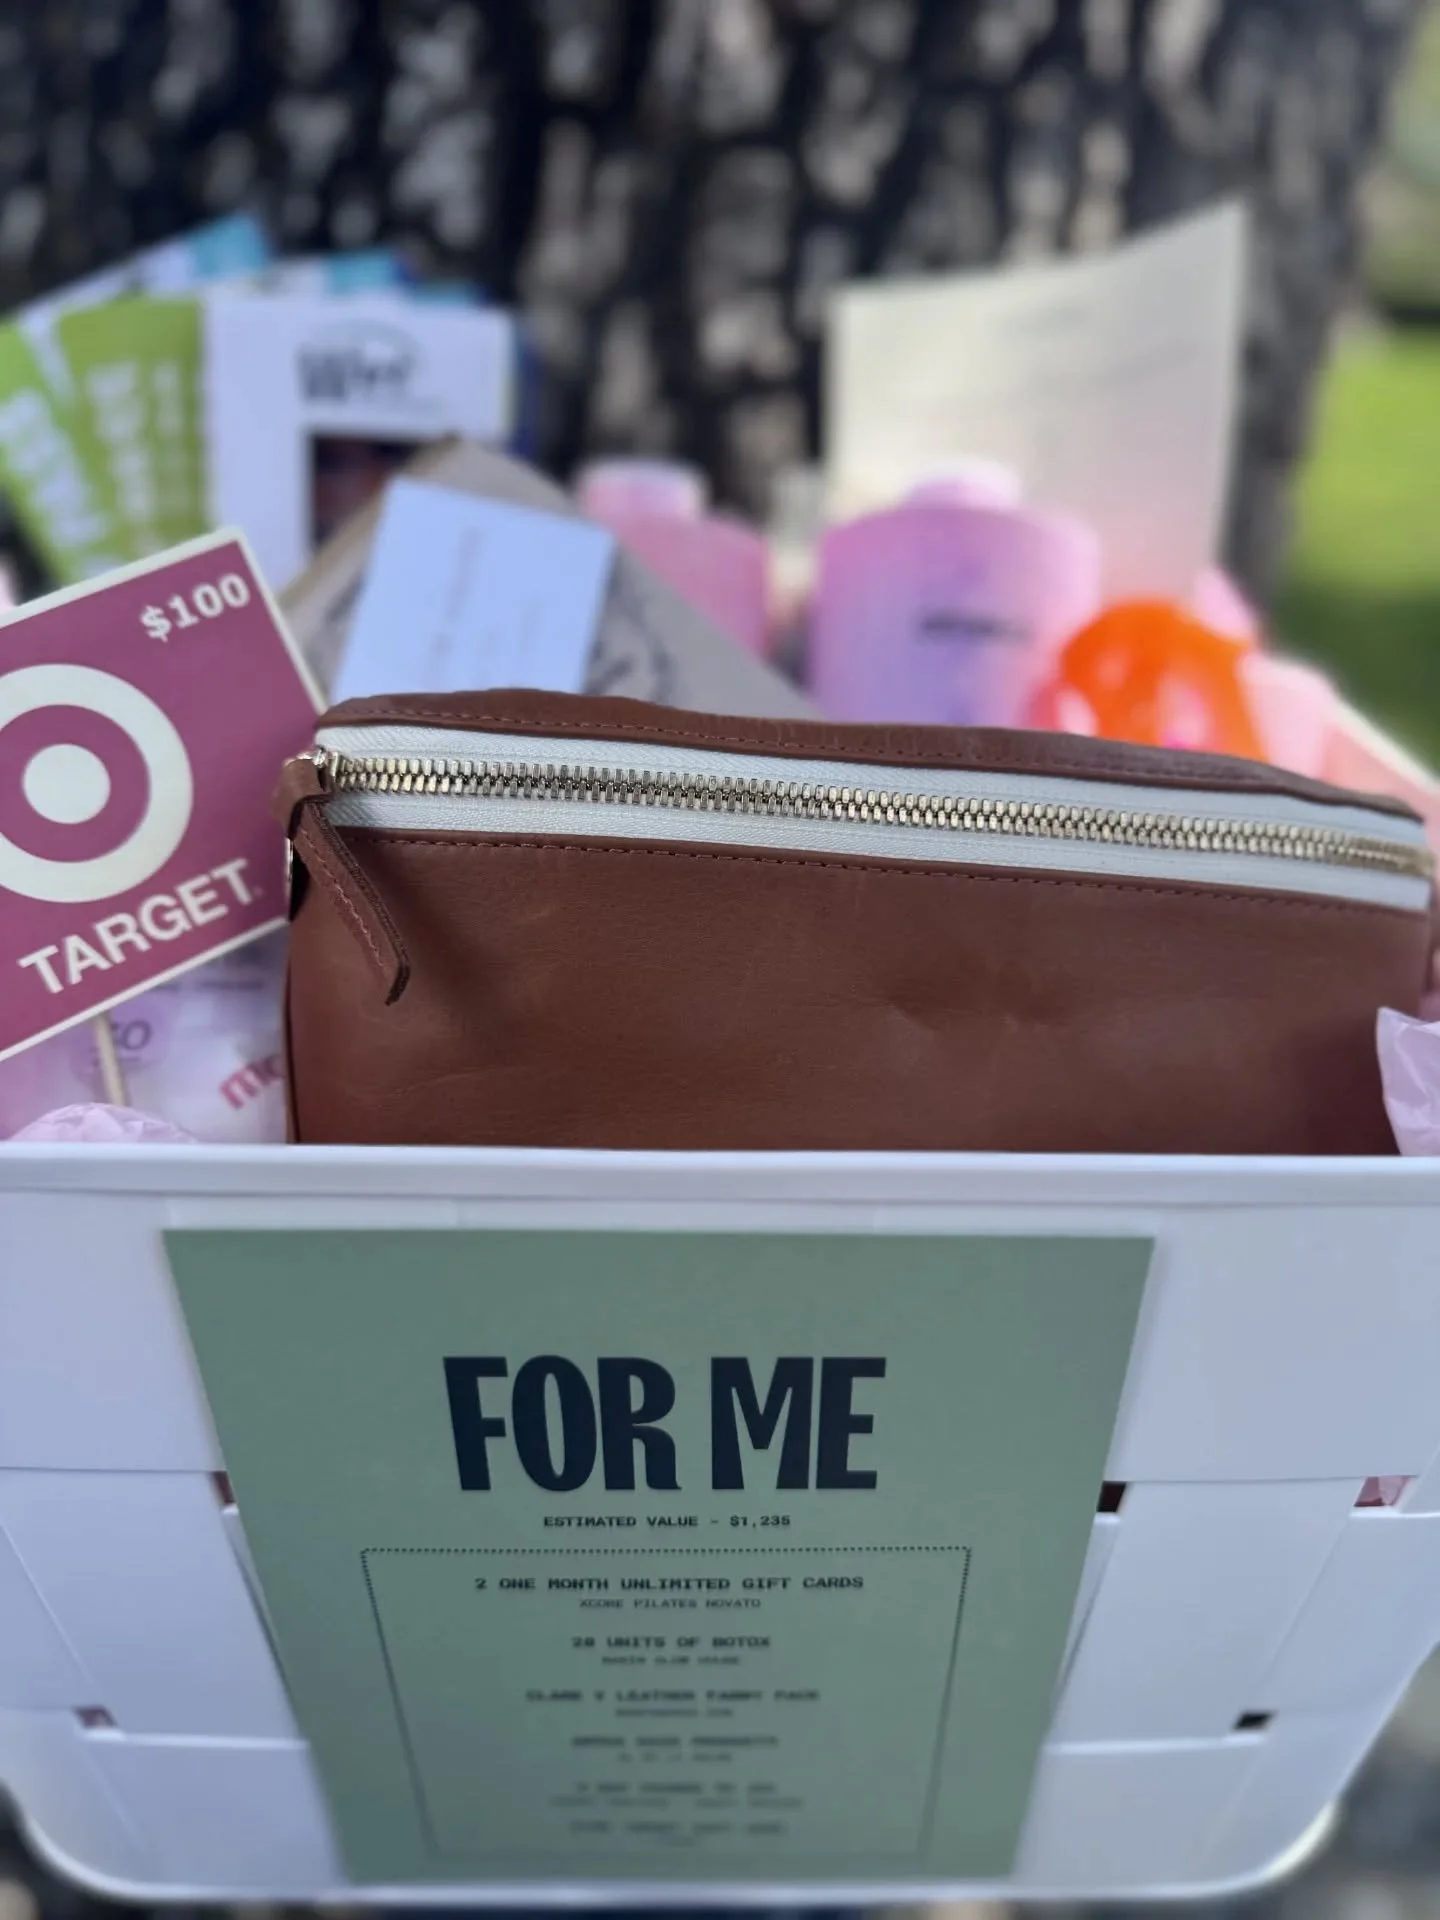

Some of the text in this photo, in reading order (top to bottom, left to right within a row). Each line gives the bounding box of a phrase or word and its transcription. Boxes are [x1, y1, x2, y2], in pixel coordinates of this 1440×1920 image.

[141, 573, 250, 643] $100
[16, 857, 249, 994] TARGET
[443, 1355, 887, 1492] FOR ME
[543, 1515, 637, 1528] ESTIMATED
[646, 1515, 699, 1528] VALUE
[729, 1514, 792, 1529] $1,235
[474, 1576, 865, 1590] 2 ONE MONTH UNLIMITED GIFT CARDS
[633, 1598, 698, 1609] PILATES
[705, 1598, 762, 1609] NOVATO
[606, 1636, 667, 1648] UNITS
[676, 1636, 700, 1648] OF
[711, 1636, 771, 1648] BOTOX
